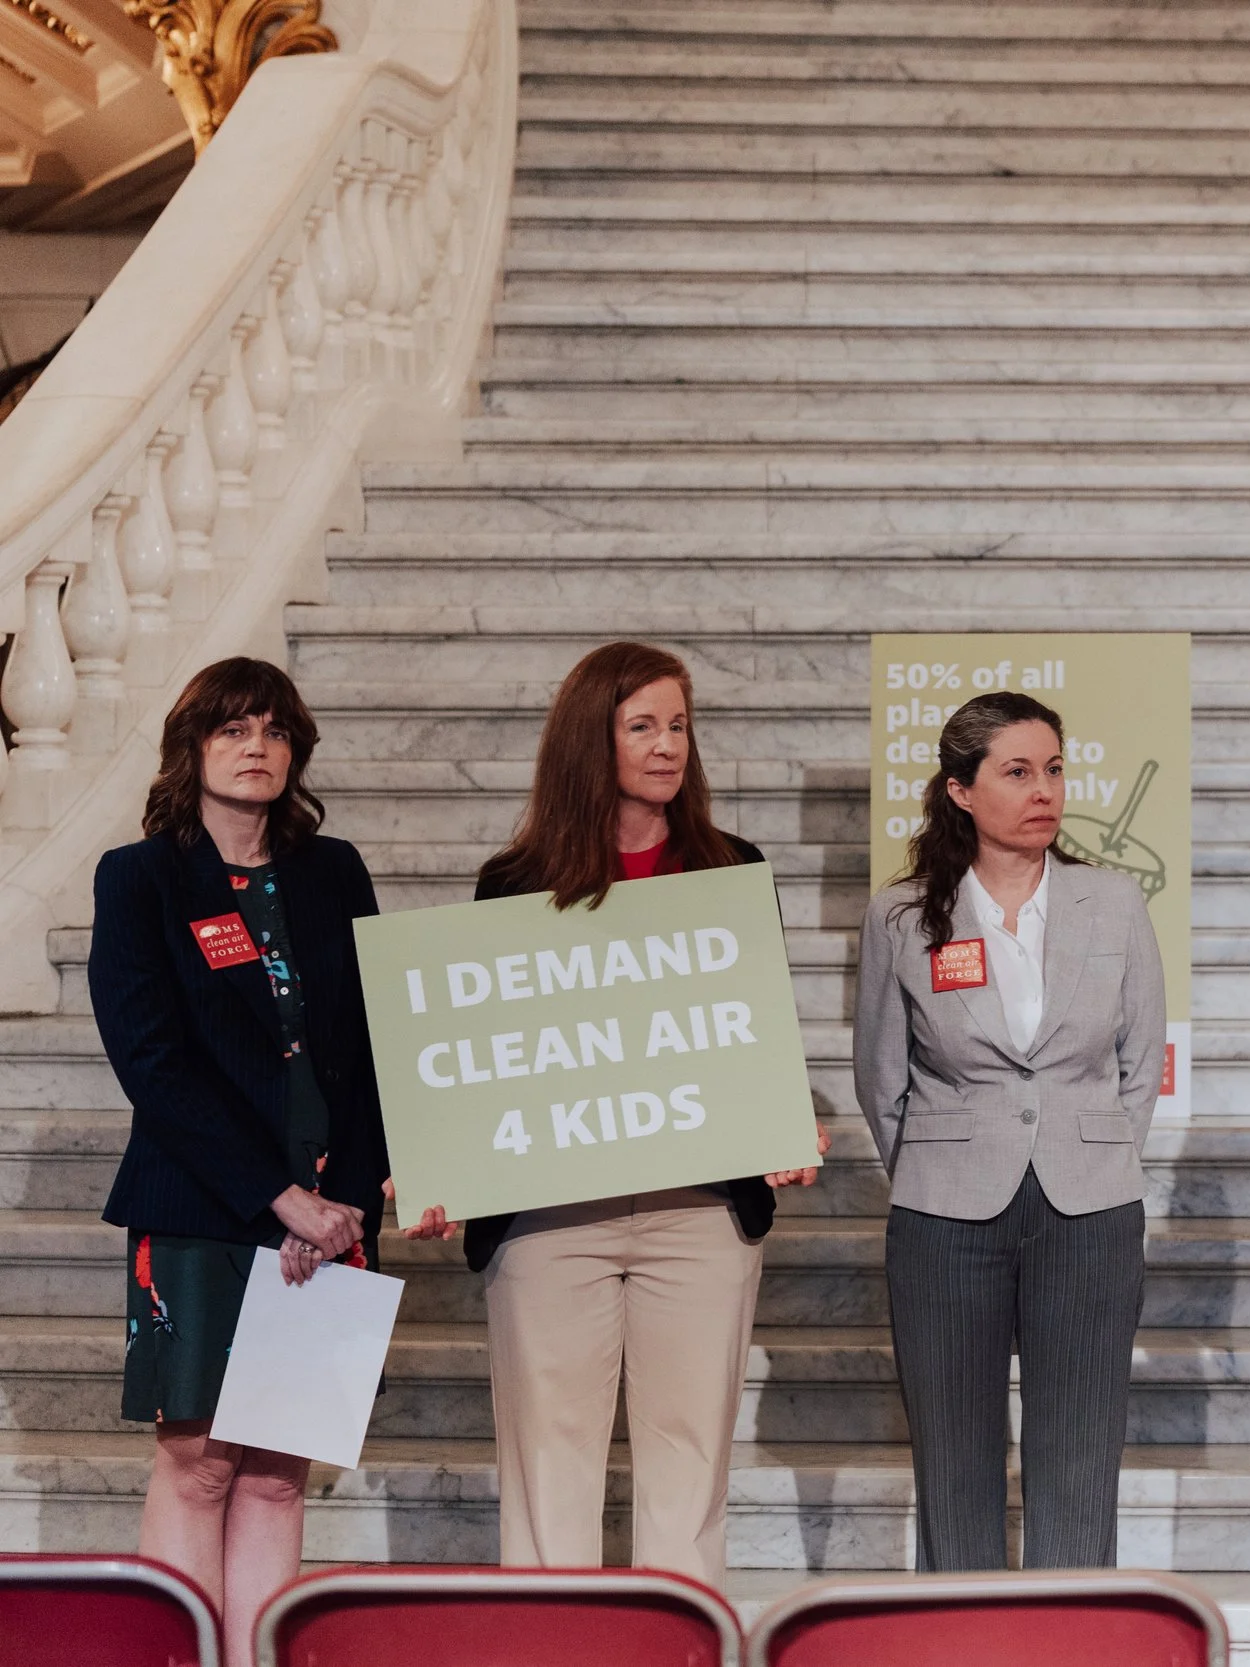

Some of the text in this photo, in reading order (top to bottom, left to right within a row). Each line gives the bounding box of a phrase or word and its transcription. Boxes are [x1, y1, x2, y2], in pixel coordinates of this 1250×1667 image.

[886, 661, 1065, 689] 50% of all
[886, 697, 959, 732] plas
[1066, 736, 1104, 764] to
[1065, 772, 1119, 807] nly
[201, 923, 239, 937] OMS
[207, 933, 244, 948] clean air
[211, 944, 250, 958] FORCE
[405, 926, 740, 1014] I DEMAND
[938, 961, 962, 970] clean
[938, 970, 980, 980] FORCE
[417, 1000, 758, 1089] CLEAN AIR
[492, 1084, 707, 1156] 4 KIDS
